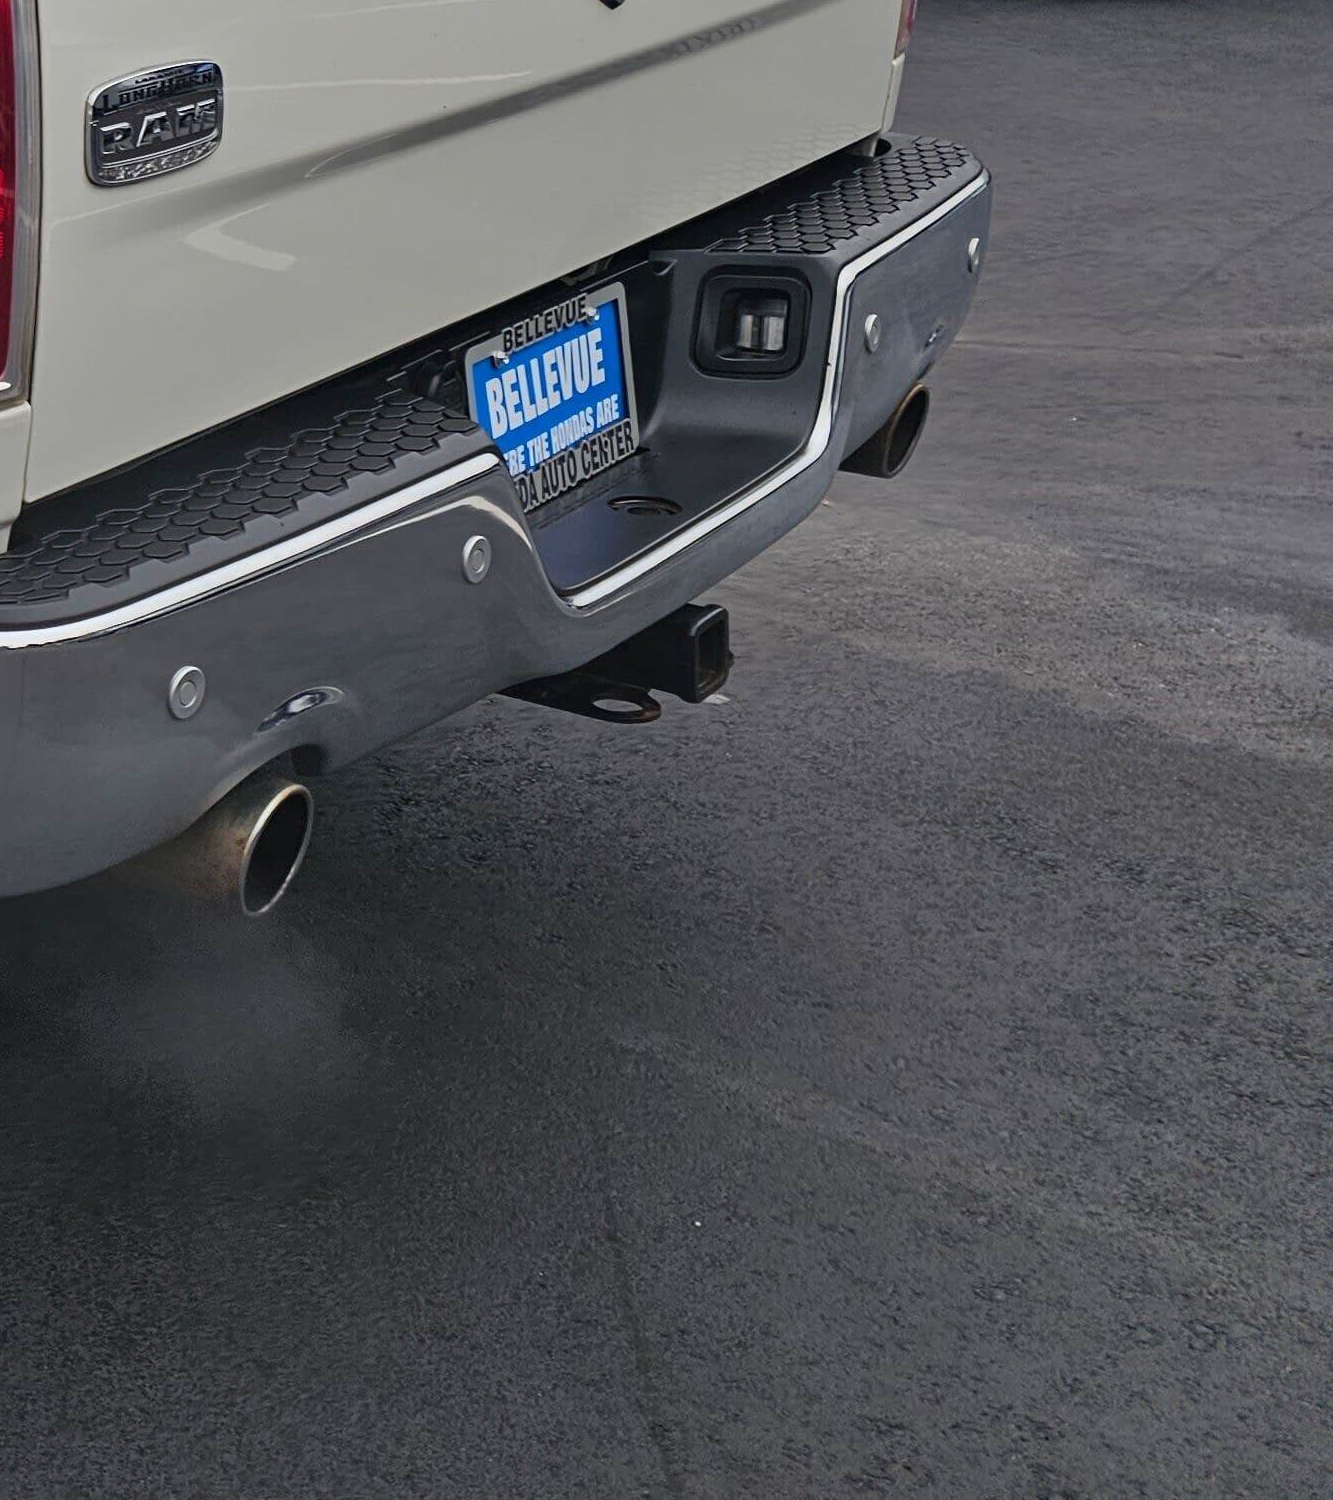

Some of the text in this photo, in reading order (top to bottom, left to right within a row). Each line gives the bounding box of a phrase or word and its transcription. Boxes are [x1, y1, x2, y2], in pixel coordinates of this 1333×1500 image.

[100, 99, 216, 154] RAM
[502, 293, 588, 352] BELLEVUE
[485, 327, 606, 440] BELLEVUE
[526, 432, 551, 467] THE
[596, 393, 620, 429] ARE
[540, 448, 577, 501] AUTO
[580, 419, 635, 478] CENTER
